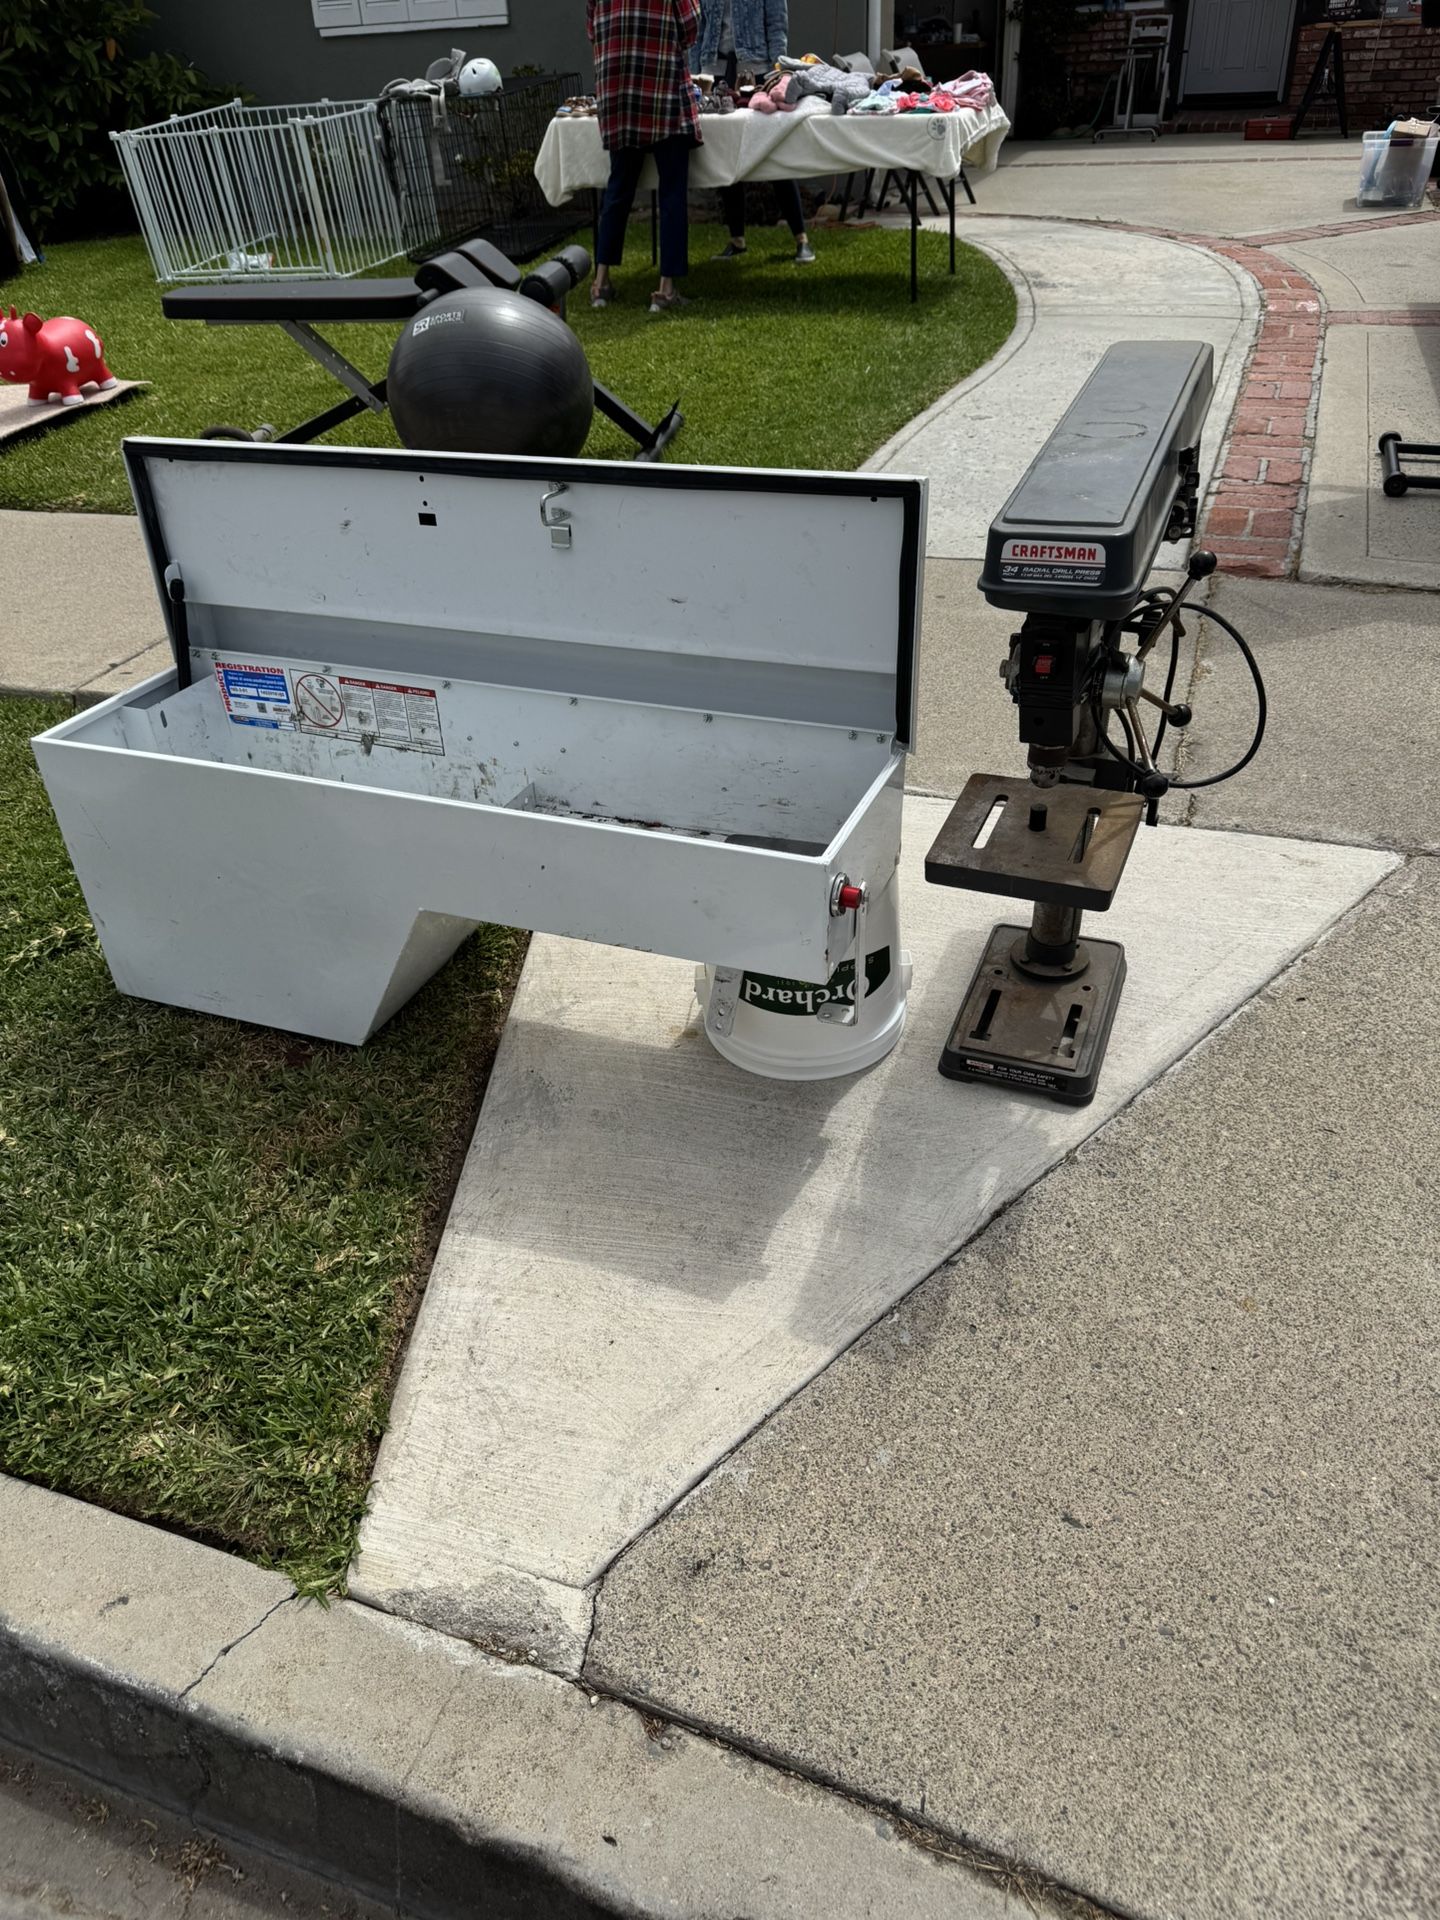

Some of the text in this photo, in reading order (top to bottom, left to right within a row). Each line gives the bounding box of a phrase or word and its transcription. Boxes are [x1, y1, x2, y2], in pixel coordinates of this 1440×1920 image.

[1011, 544, 1097, 561] CRAFTSMAN
[1002, 565, 1019, 573] 34
[215, 662, 284, 674] REGISTRATION
[216, 669, 233, 712] PRODUCT
[1036, 1073, 1055, 1081] SAFETY
